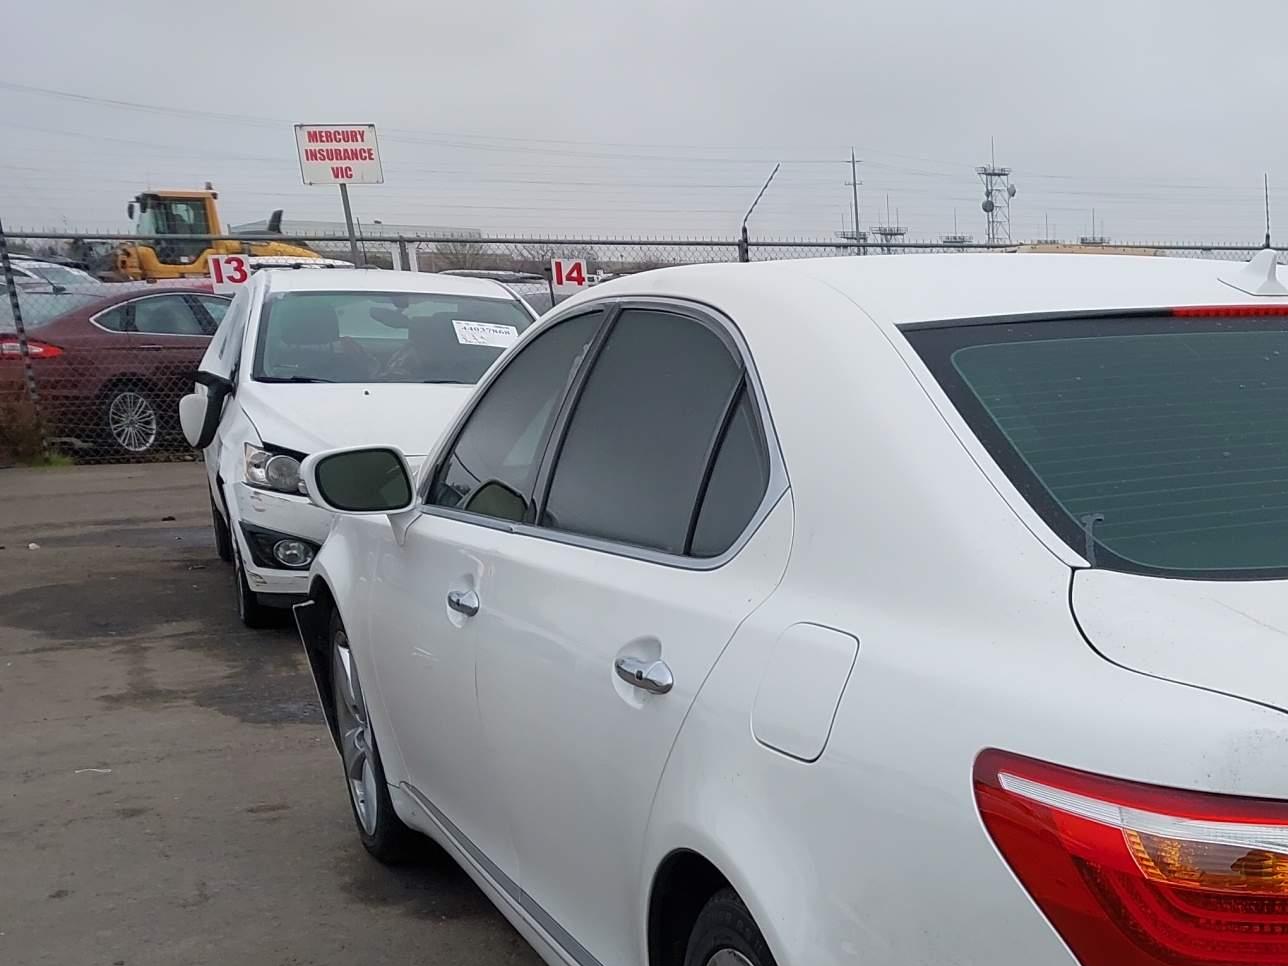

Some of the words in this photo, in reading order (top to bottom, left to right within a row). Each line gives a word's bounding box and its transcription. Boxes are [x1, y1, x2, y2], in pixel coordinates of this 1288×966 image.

[306, 129, 366, 144] MERCURY
[304, 147, 375, 163] INSURANCE
[331, 165, 353, 180] VIC
[211, 256, 248, 284] 13
[554, 261, 586, 287] 14
